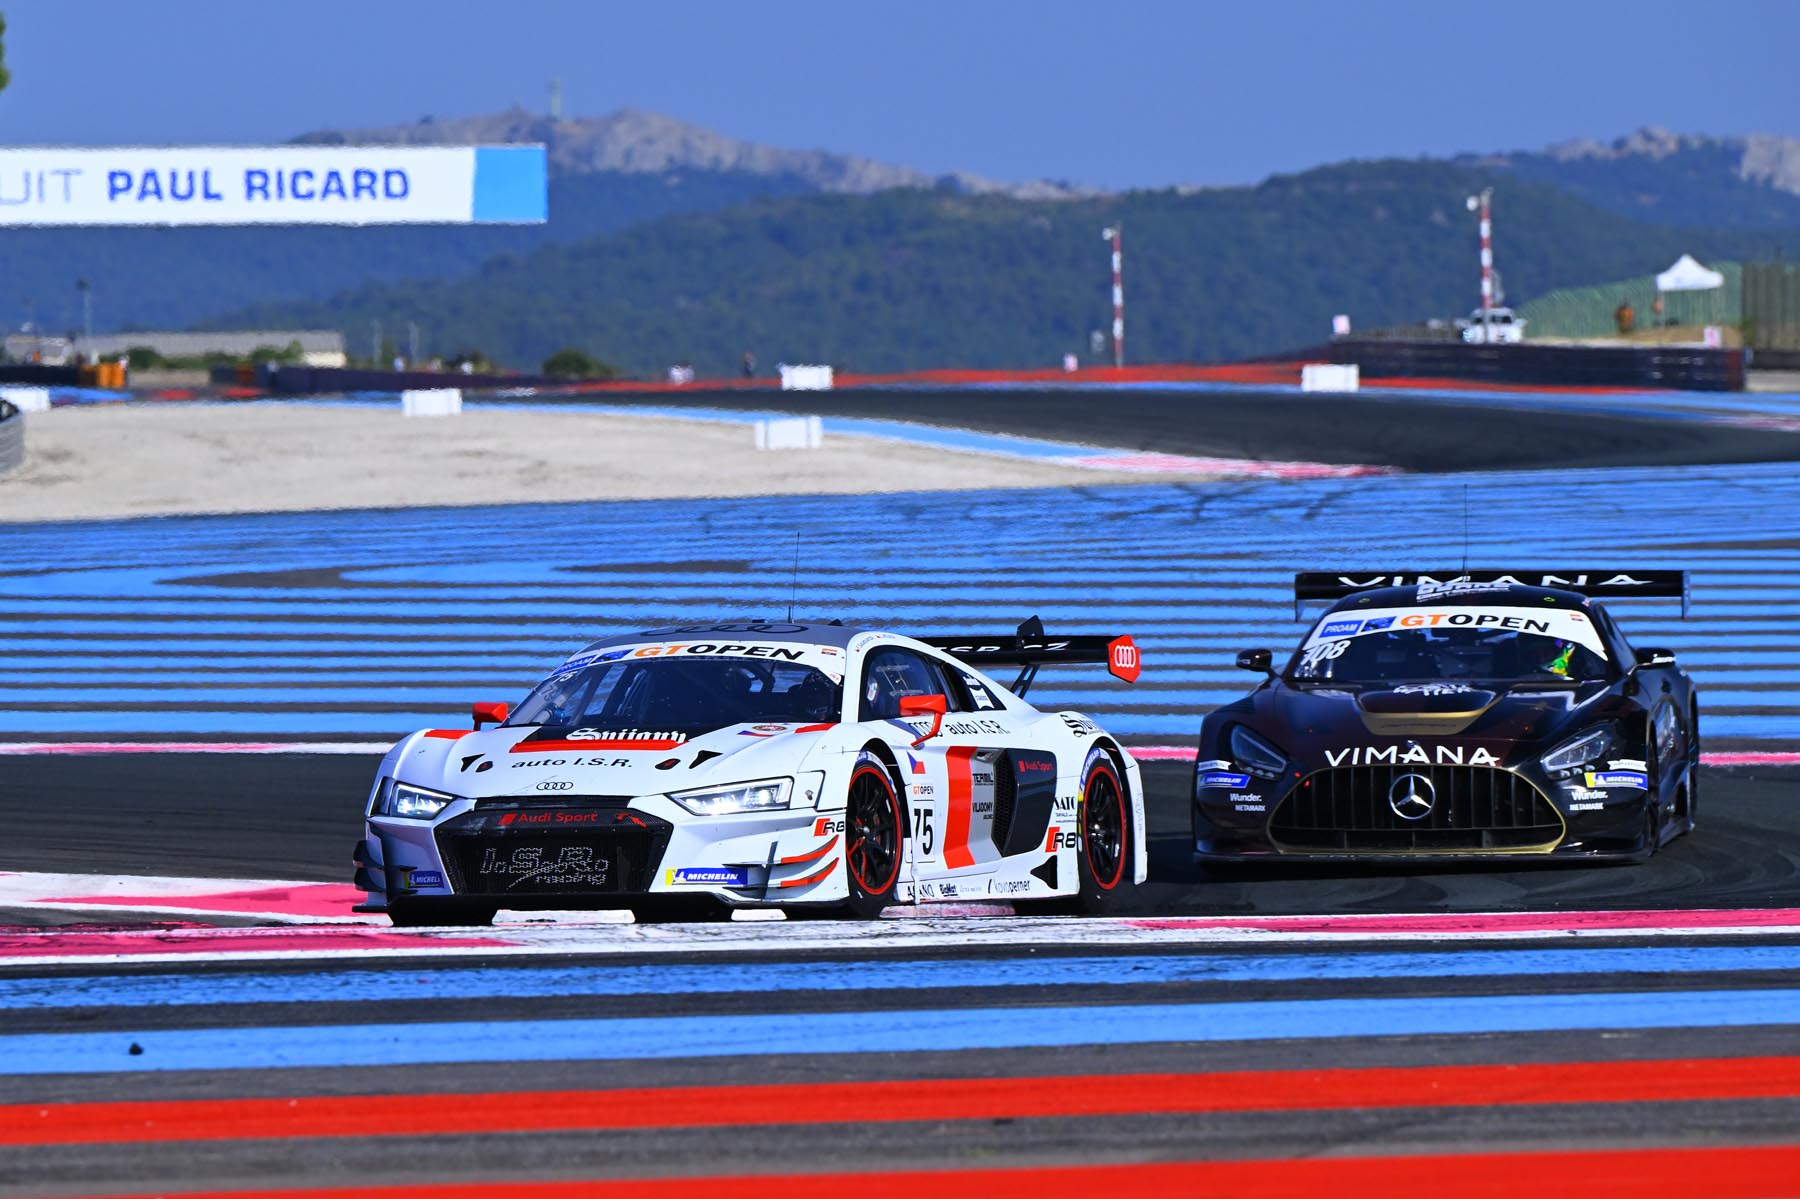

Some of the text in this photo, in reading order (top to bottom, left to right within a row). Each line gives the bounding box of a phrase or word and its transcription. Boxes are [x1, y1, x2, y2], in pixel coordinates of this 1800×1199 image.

[108, 169, 222, 201] PAUL
[245, 169, 409, 201] RICARD
[1338, 575, 1653, 588] VIMANA
[1324, 623, 1358, 634] PROAM
[945, 721, 978, 736] auto
[511, 757, 633, 768] auto I.S.R.
[1324, 745, 1501, 767] VIMANA
[1605, 776, 1644, 784] MICHELIN
[518, 812, 598, 824] Audi Sport
[822, 821, 845, 834] R8
[913, 808, 934, 855] 75
[1052, 831, 1077, 849] R8
[687, 873, 739, 881] MICHELIN
